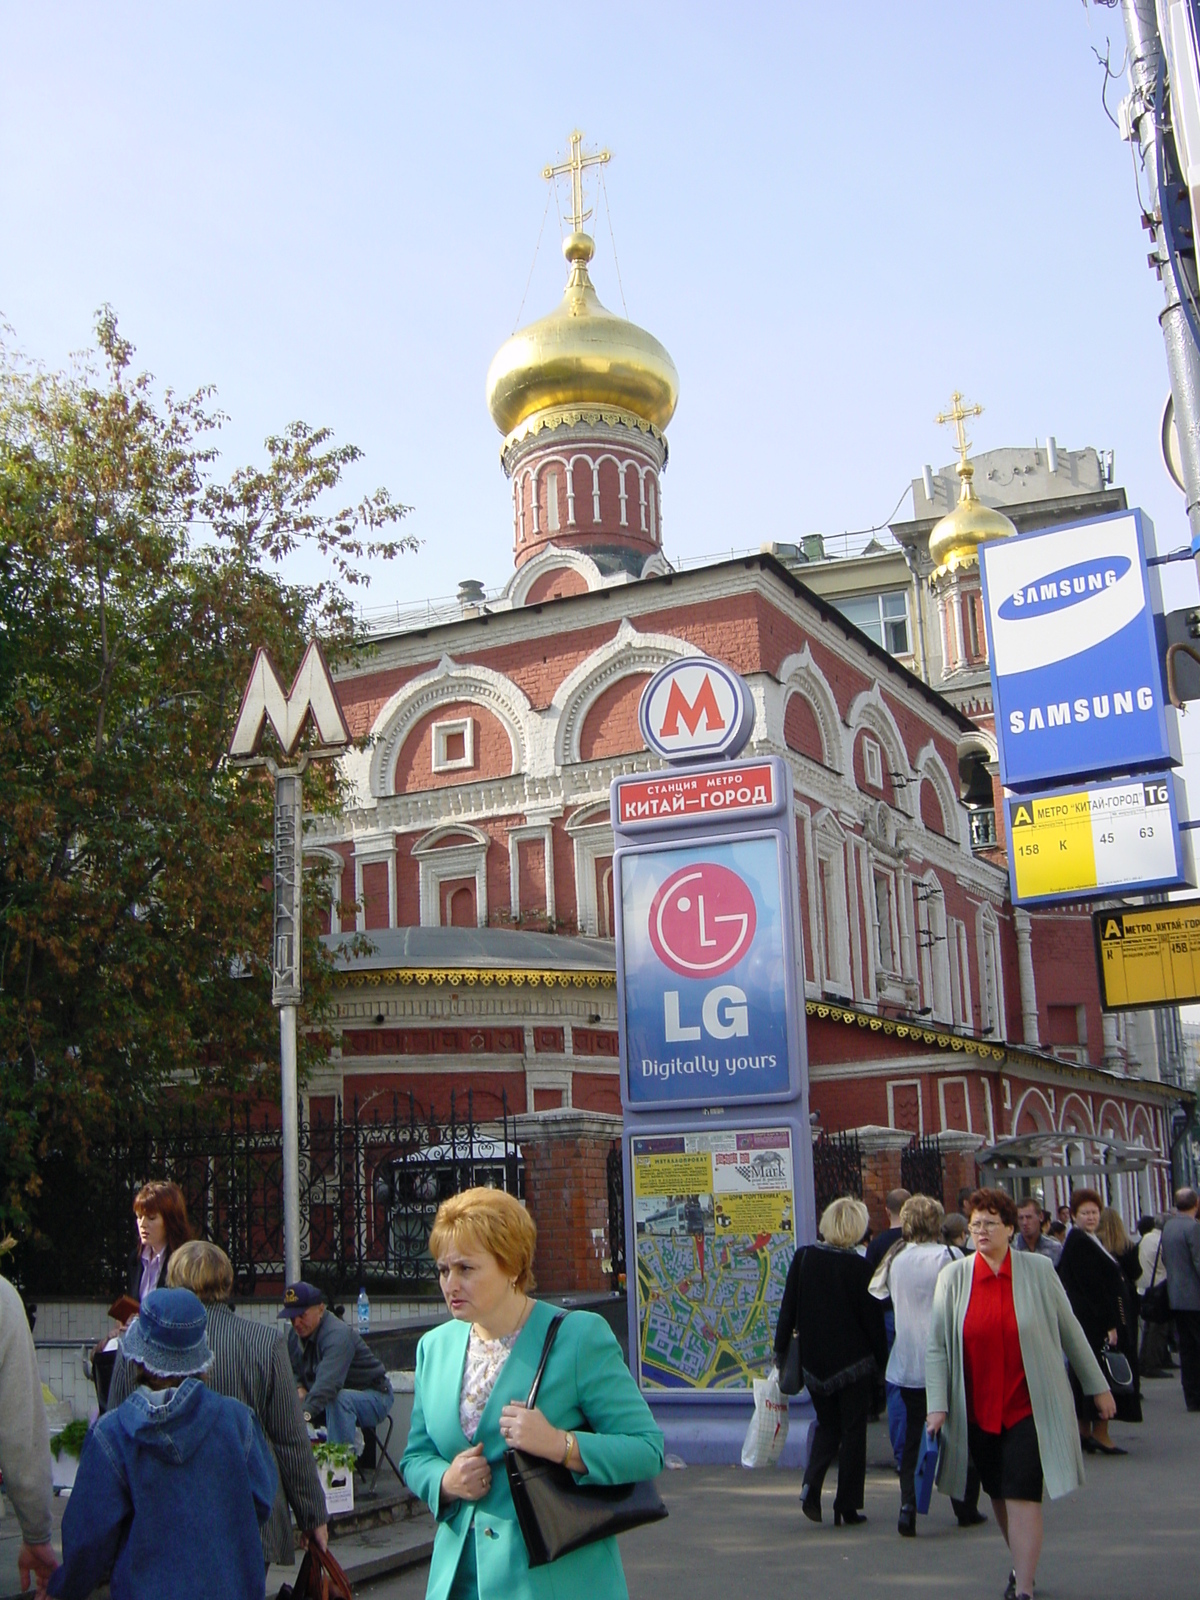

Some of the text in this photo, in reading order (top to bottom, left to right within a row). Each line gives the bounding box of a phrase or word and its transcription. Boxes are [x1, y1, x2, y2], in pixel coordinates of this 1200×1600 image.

[1013, 569, 1117, 607] SAMSUNG
[1009, 686, 1154, 735] SAMSUNG
[647, 774, 743, 795] СТАНЦИЯ МЕТРО
[1145, 785, 1169, 804] Тб
[625, 785, 767, 818] КИТАЙ-ГОРОД
[1014, 806, 1033, 826] А
[1037, 804, 1069, 819] МЕТРО
[1018, 826, 1154, 857] 158 К 45 63
[1104, 919, 1122, 939] А
[1125, 923, 1152, 935] МЕТРО
[1171, 942, 1188, 954] 158
[663, 984, 749, 1043] LG
[642, 1055, 777, 1081] Digitally yours
[751, 1163, 786, 1178] Mark
